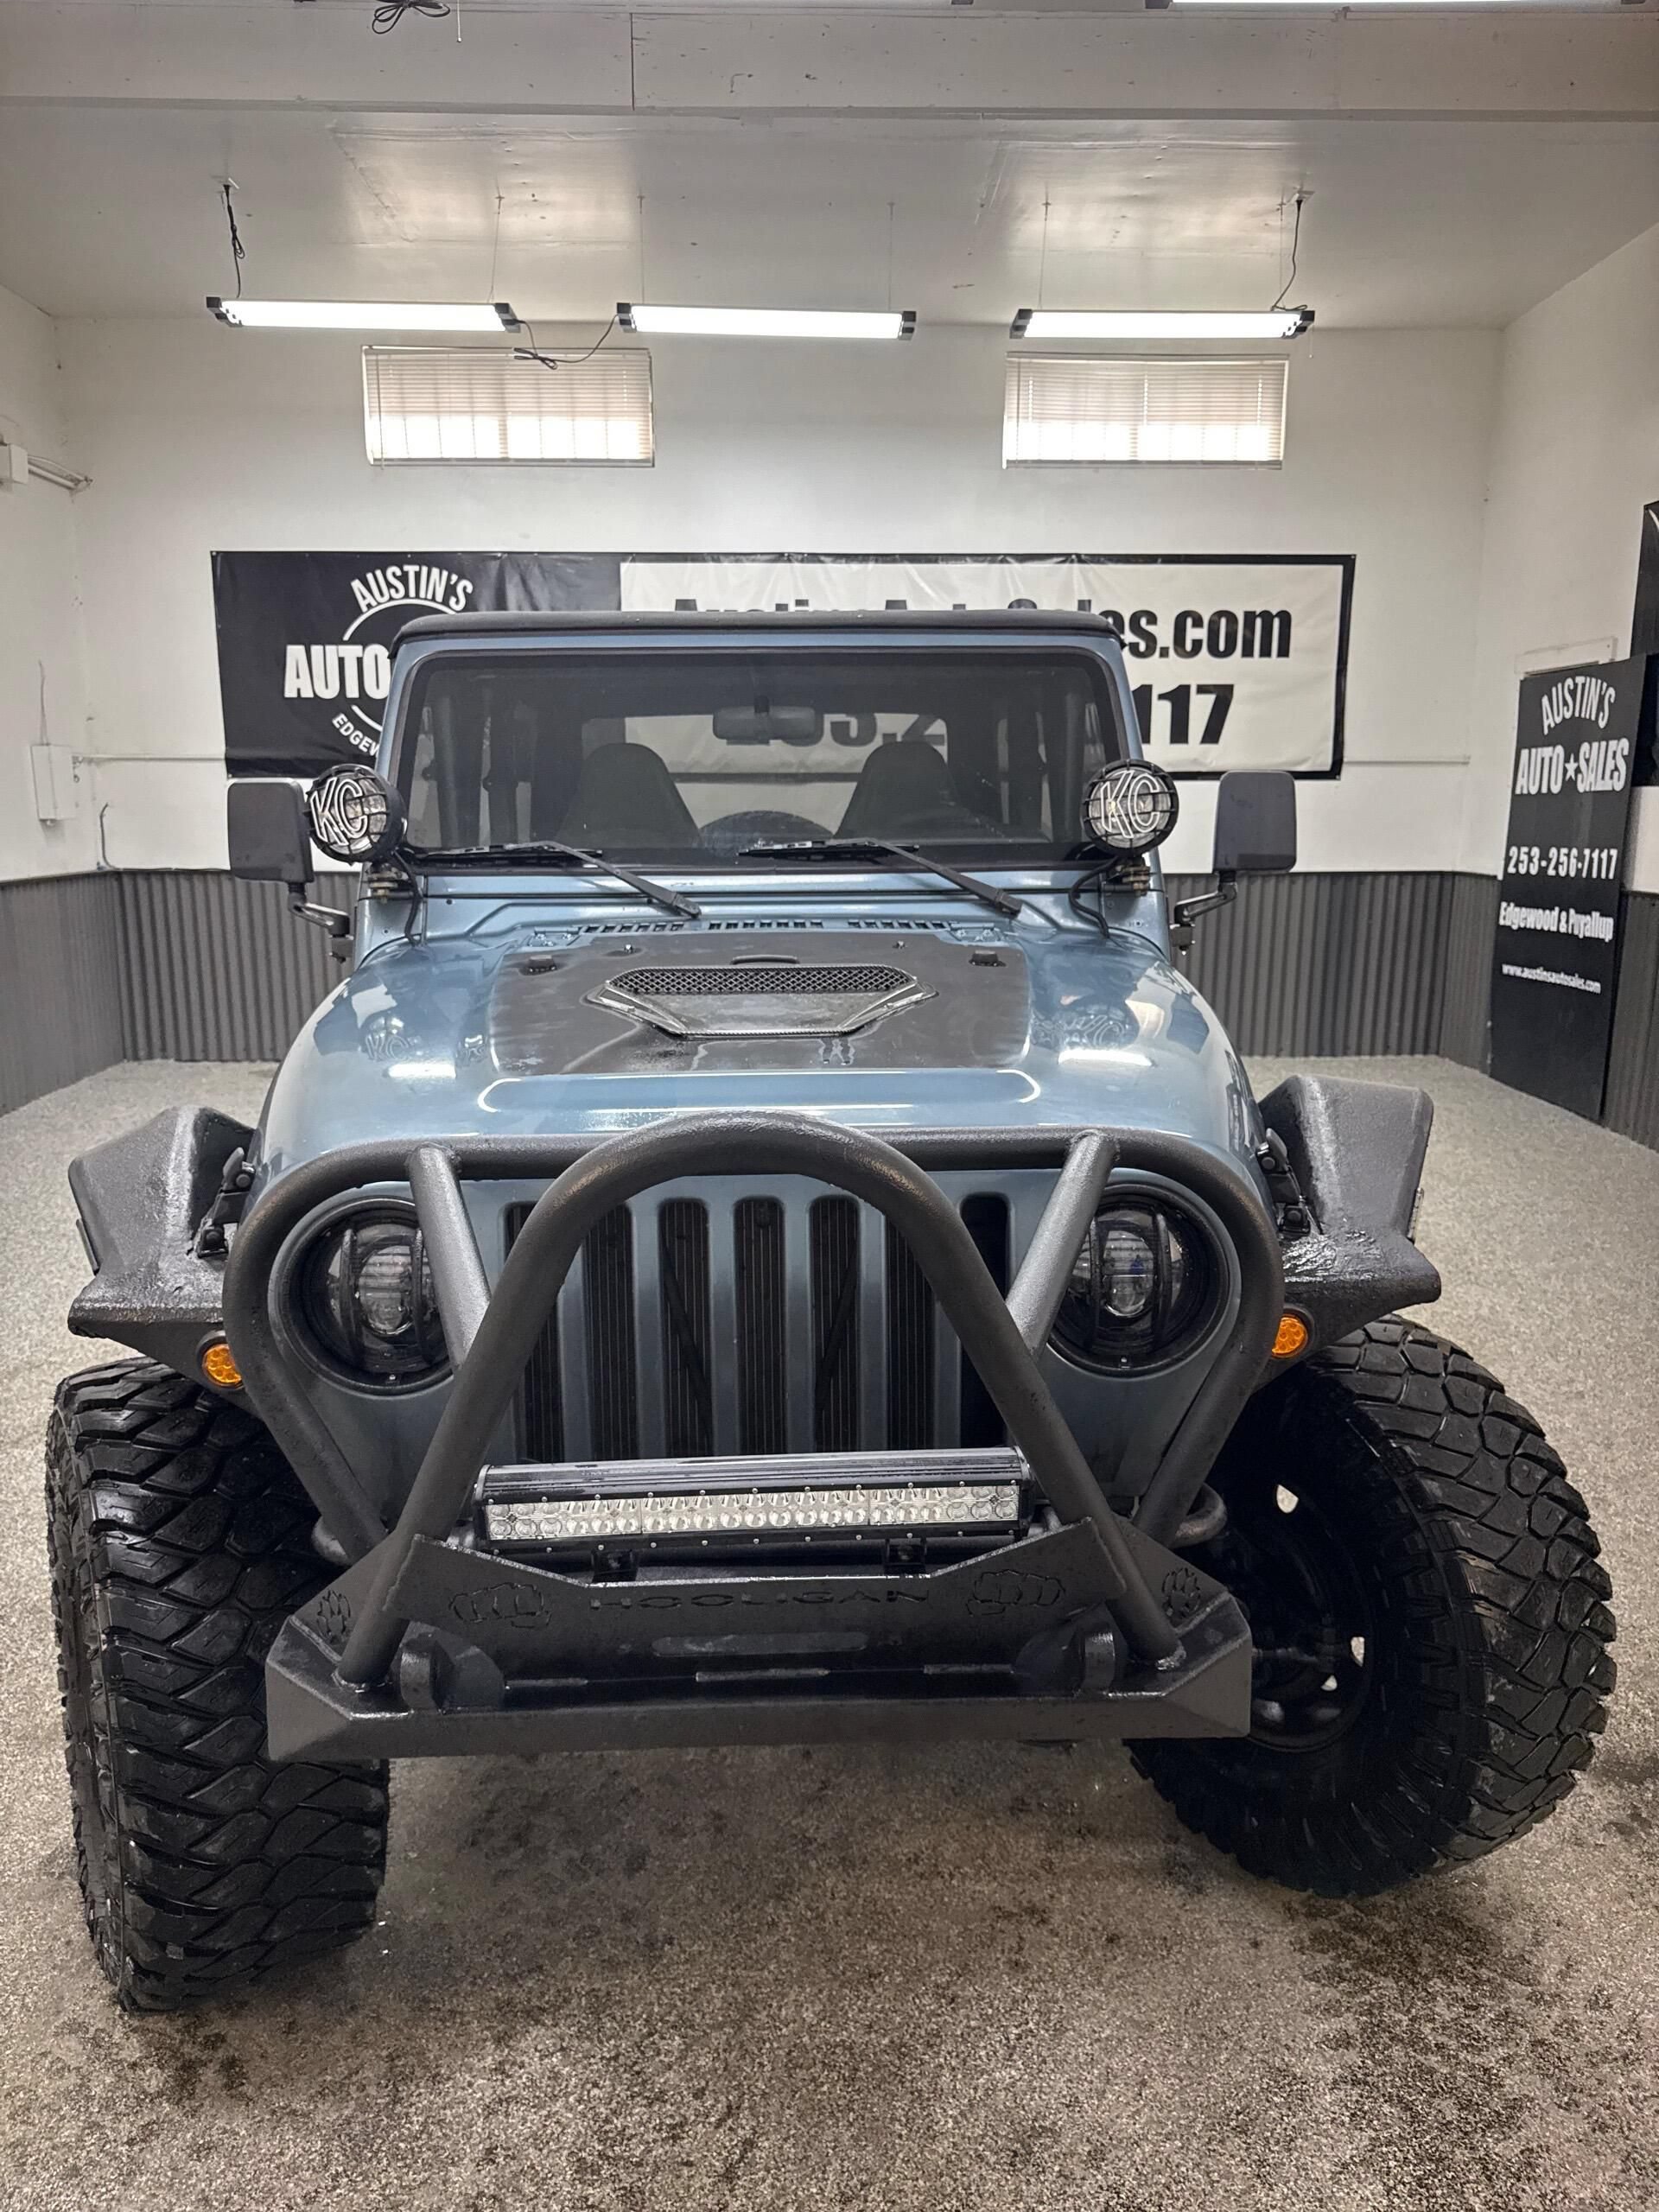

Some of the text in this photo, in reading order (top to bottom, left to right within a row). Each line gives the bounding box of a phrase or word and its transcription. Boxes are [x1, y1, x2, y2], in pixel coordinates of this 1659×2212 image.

[350, 563, 474, 613] AUSTIN'S
[283, 644, 391, 699] AUTO
[1541, 675, 1616, 735] AUSTIN'S
[1515, 737, 1630, 795] AUTO SALES
[310, 777, 368, 846] KC
[1100, 770, 1160, 839] KC
[1498, 900, 1614, 943] Edgewood & Puyallup
